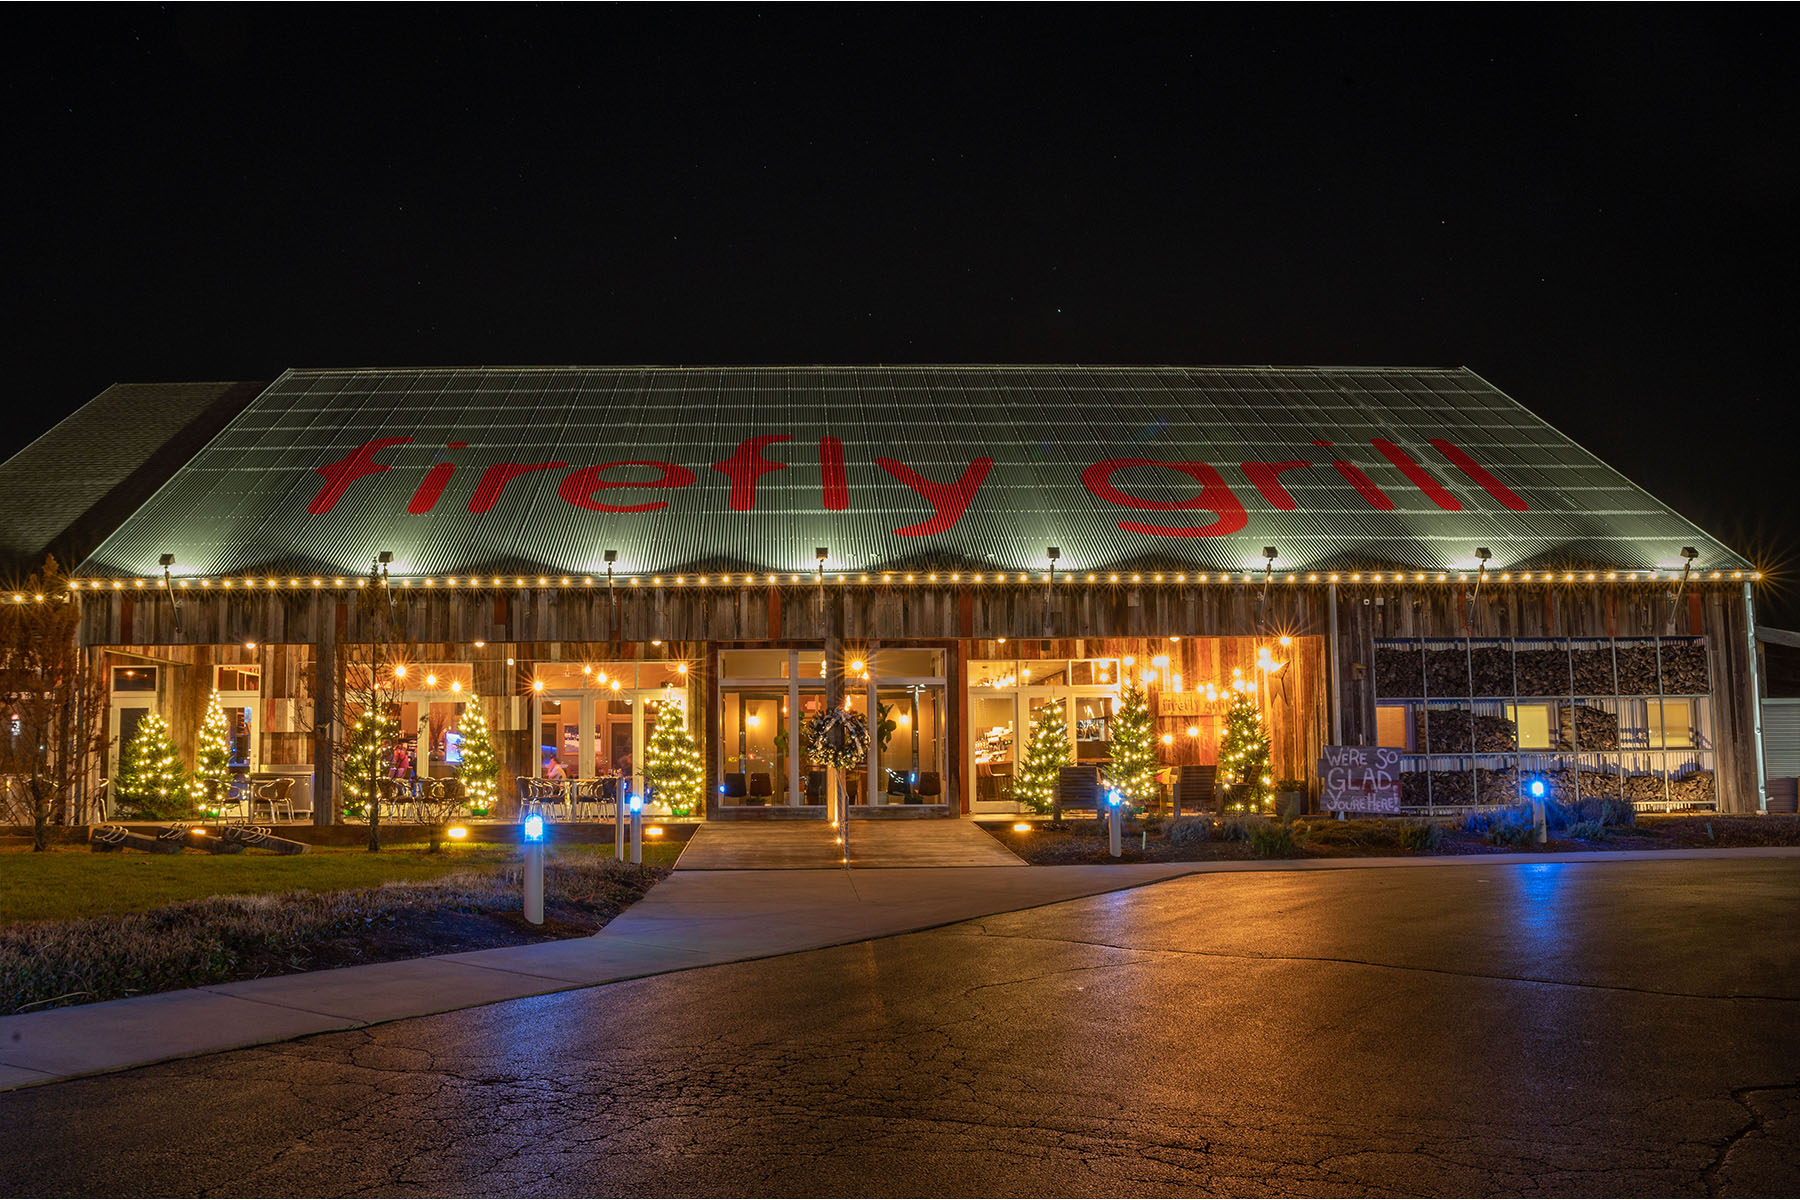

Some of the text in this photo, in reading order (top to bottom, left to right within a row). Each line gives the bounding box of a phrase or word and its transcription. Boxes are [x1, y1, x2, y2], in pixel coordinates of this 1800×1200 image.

[307, 434, 1530, 538] firefly grill
[1375, 748, 1399, 770] SO
